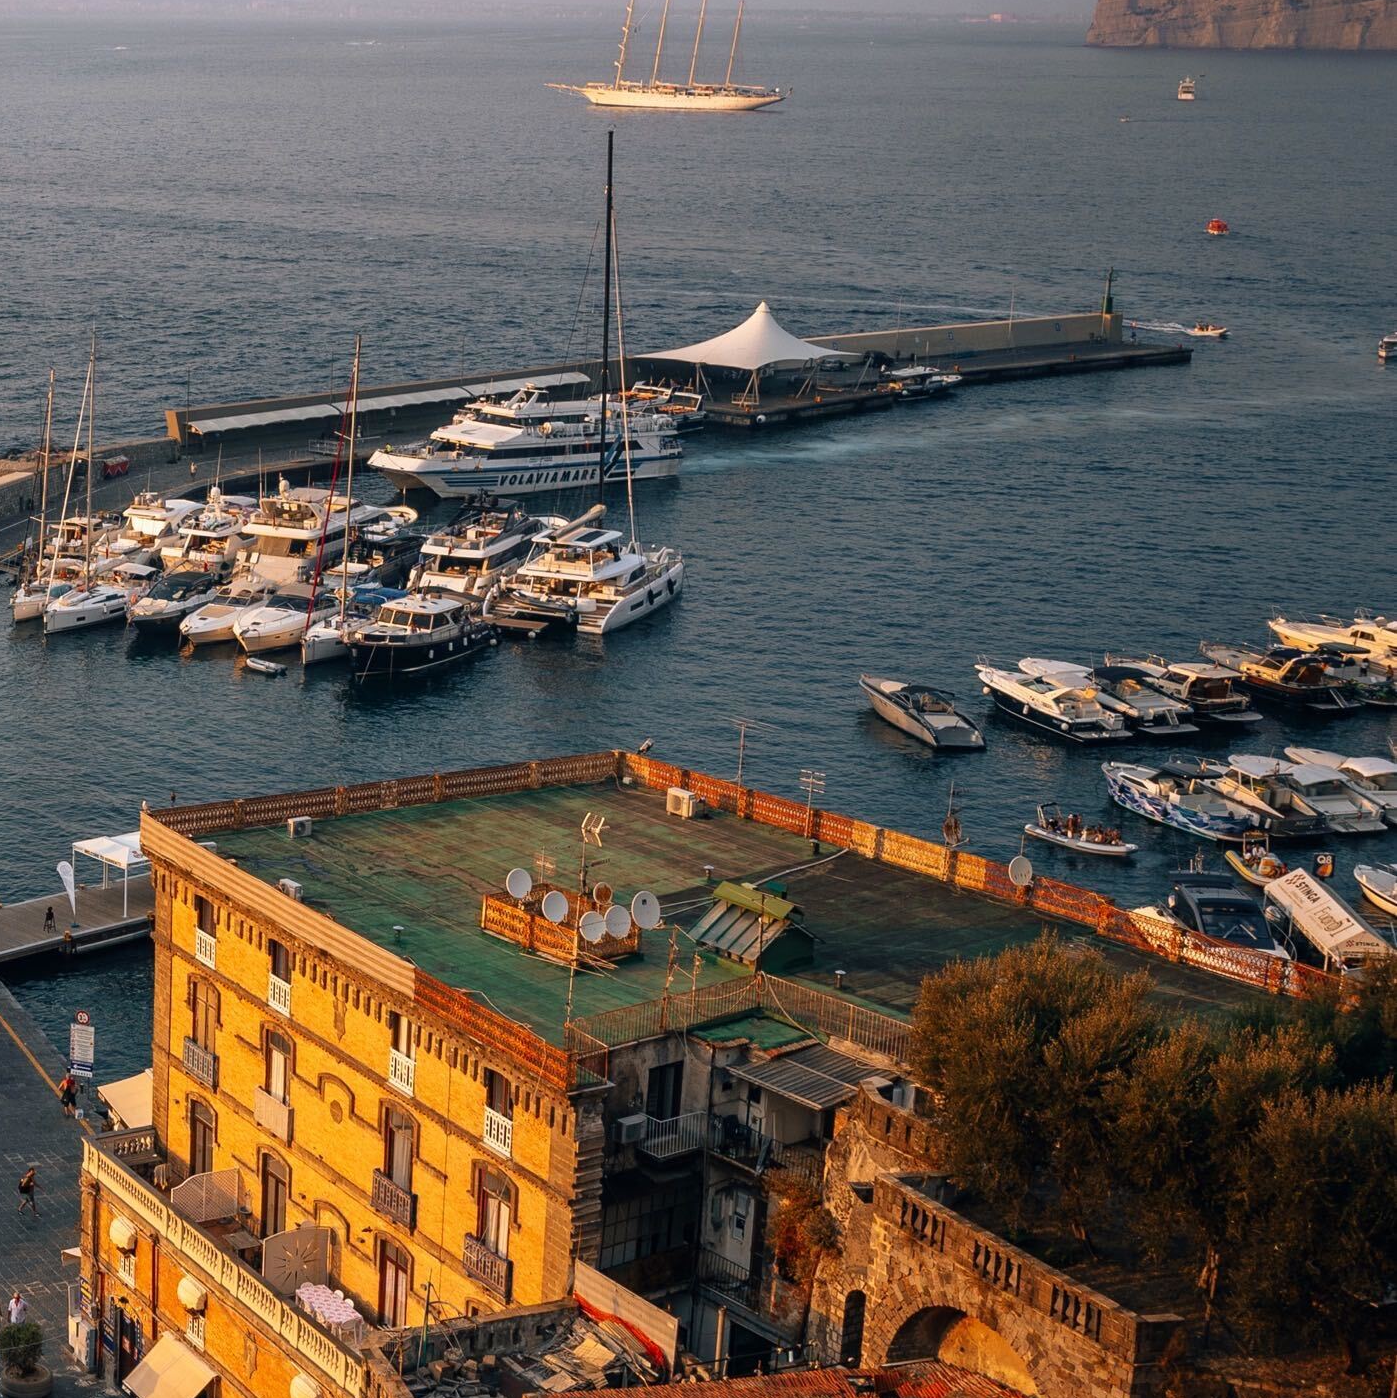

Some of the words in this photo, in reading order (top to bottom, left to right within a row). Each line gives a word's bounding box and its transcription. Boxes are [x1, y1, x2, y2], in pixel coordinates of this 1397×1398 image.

[499, 468, 597, 486] VOLAVIAMARE
[1316, 855, 1333, 864] Q8
[1296, 881, 1321, 904] STINGA
